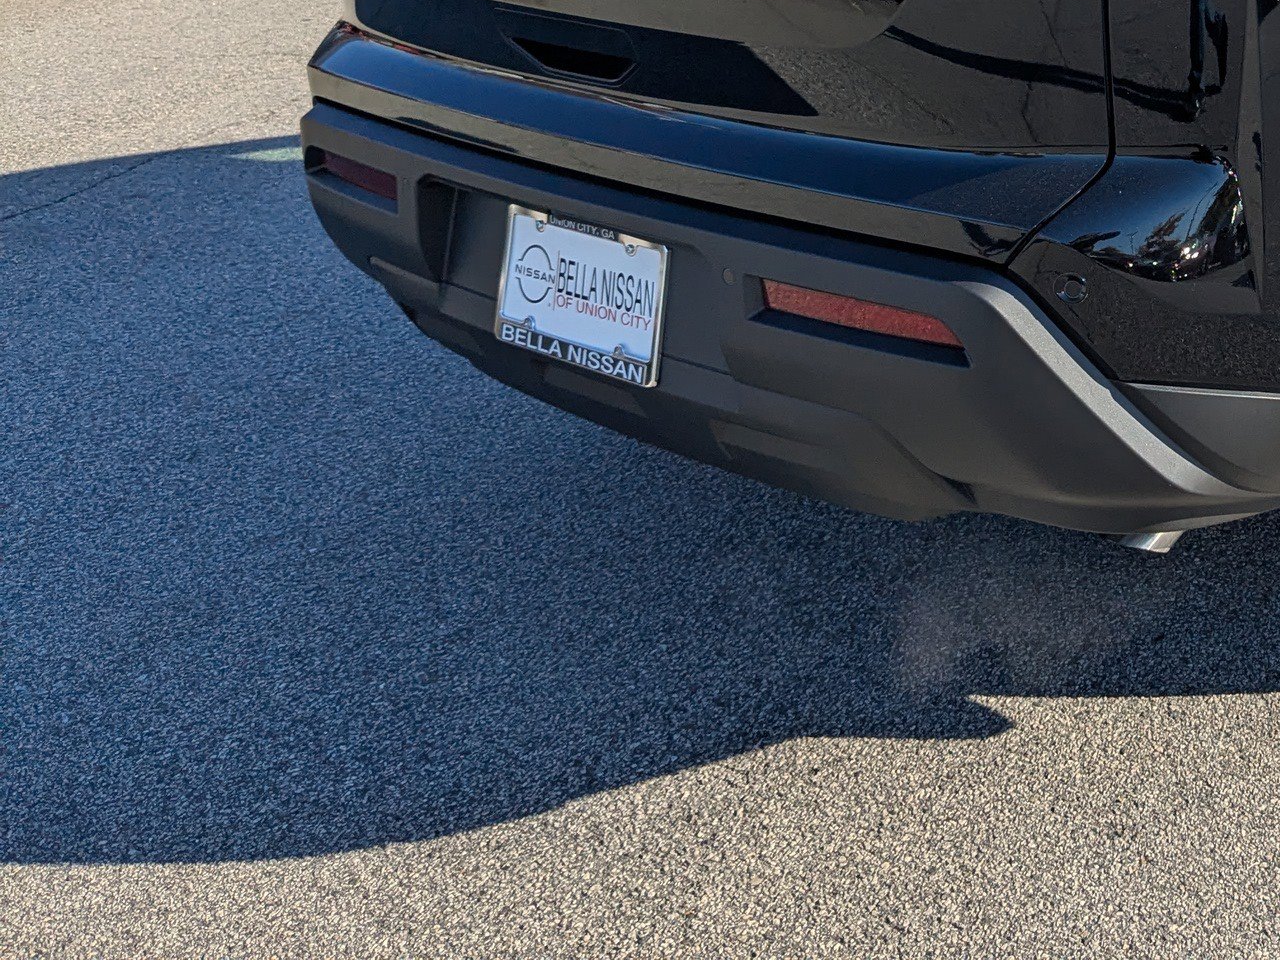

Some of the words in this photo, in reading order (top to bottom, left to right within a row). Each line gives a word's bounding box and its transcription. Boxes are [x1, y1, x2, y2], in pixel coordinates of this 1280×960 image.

[549, 215, 576, 230] UNION
[577, 221, 600, 236] CITY,
[601, 226, 615, 240] GA
[514, 263, 556, 284] NISSAN
[557, 258, 598, 301] BELLA
[601, 269, 655, 317] NISSAN
[556, 294, 573, 310] OF
[577, 299, 618, 323] UNION
[620, 311, 653, 331] CITY
[501, 323, 563, 359] BELLA
[567, 344, 643, 384] NISSAN
